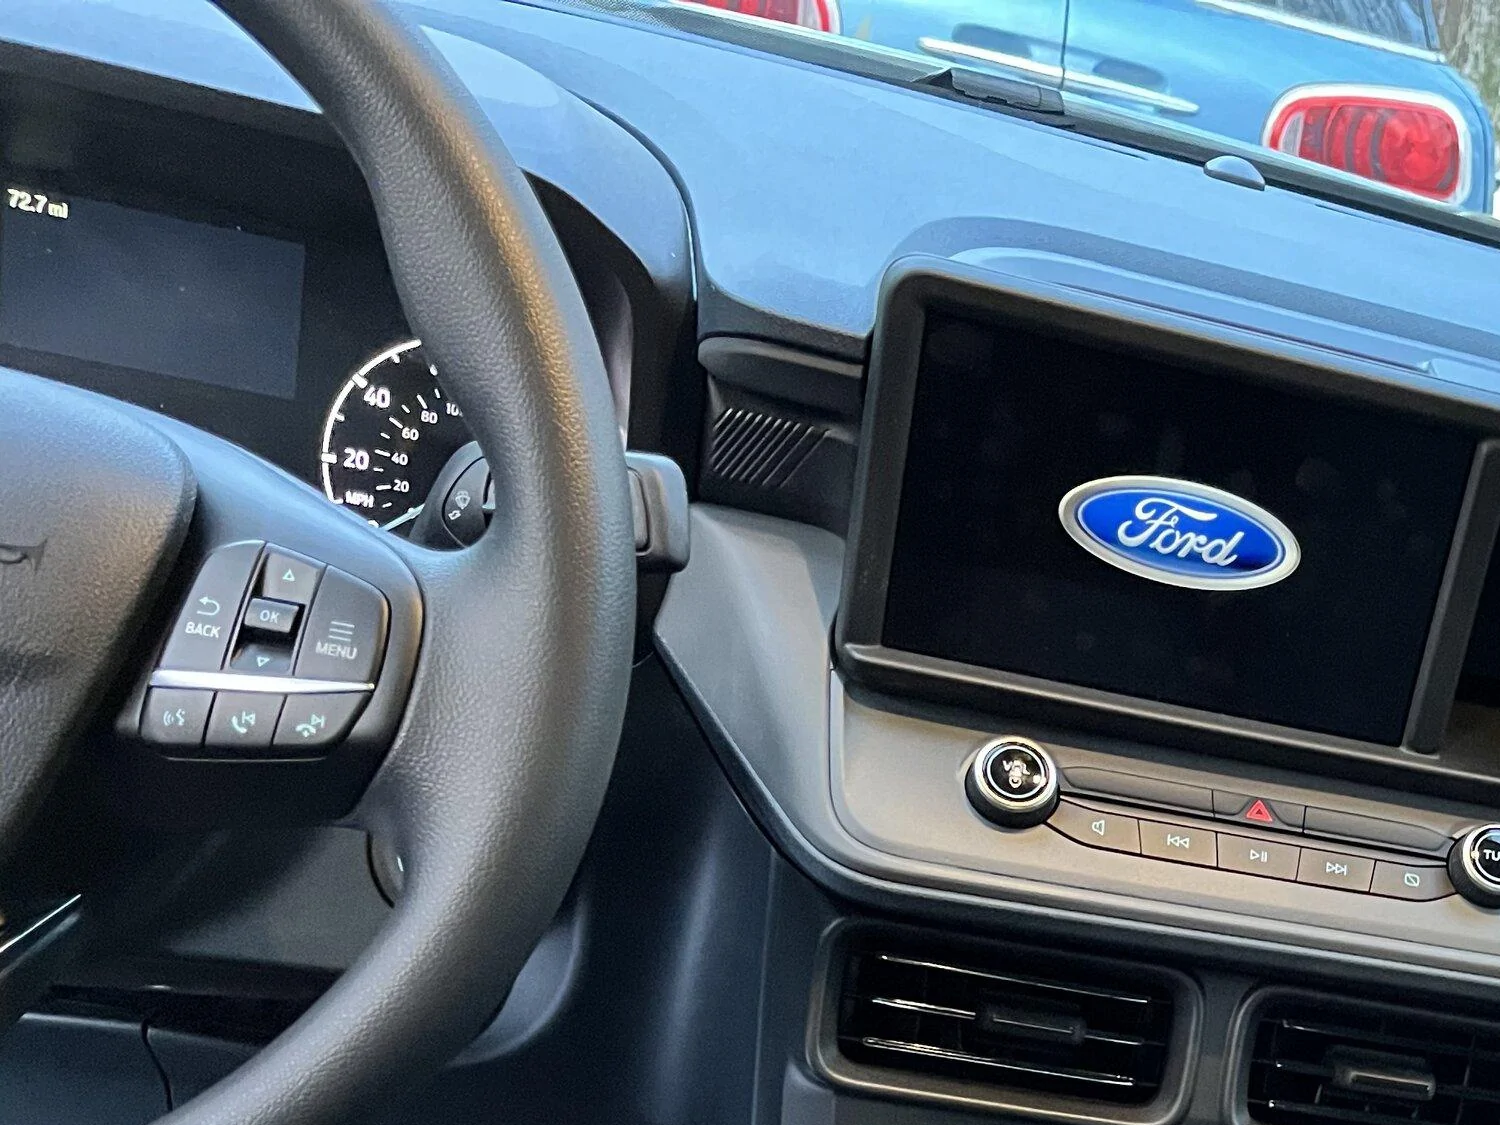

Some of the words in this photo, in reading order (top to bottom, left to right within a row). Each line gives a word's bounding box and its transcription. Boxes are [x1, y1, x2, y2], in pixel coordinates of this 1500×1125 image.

[363, 385, 391, 409] 40
[420, 410, 438, 424] 80
[445, 402, 463, 418] 10
[401, 427, 419, 441] 60
[343, 447, 370, 471] 20
[390, 452, 408, 466] 40
[392, 479, 410, 493] 20
[345, 490, 375, 509] MPH
[1117, 497, 1245, 567] Ford
[259, 609, 280, 624] OK
[184, 621, 222, 639] BACK
[315, 641, 358, 660] MENU
